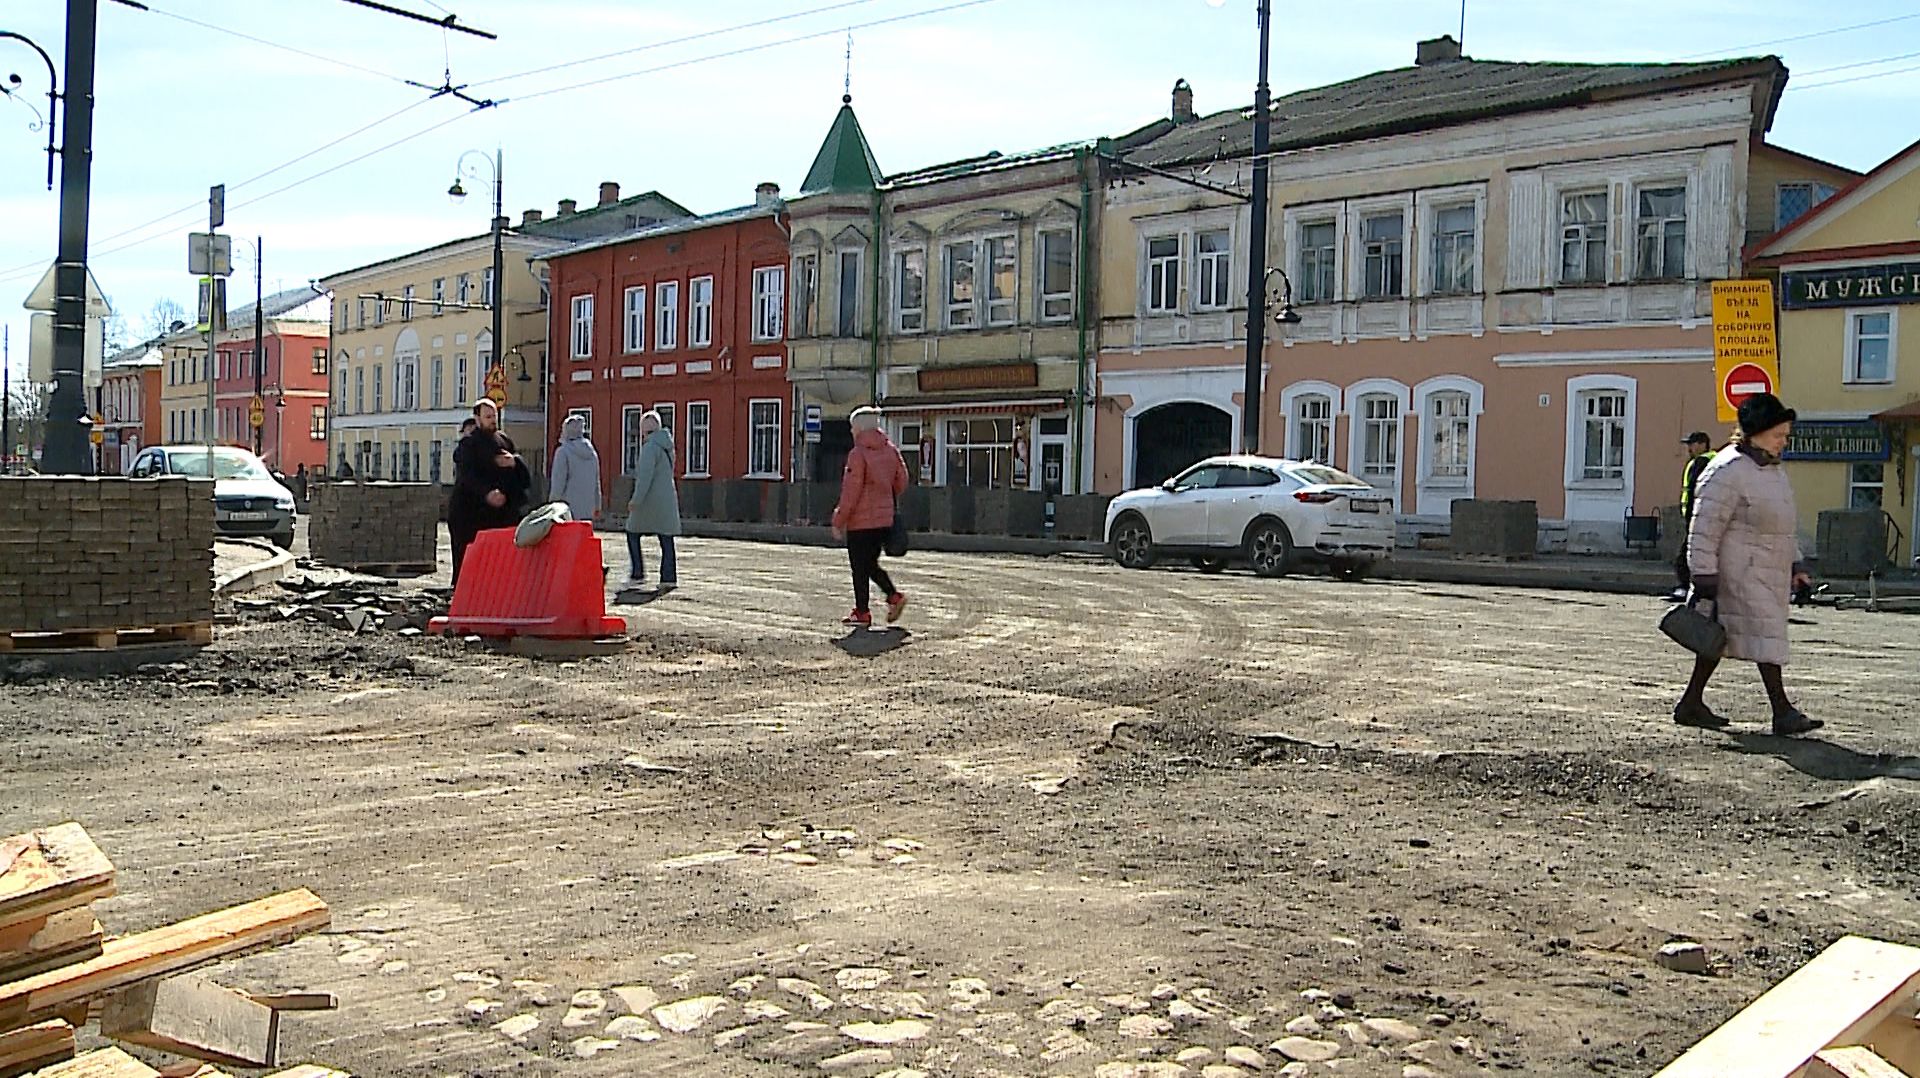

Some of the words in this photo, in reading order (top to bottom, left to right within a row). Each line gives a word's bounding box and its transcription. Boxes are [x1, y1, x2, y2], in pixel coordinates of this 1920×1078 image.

[1713, 285, 1770, 294] ВНИМАНИЕ!
[1726, 298, 1759, 307] ВЪЕЗД
[1736, 310, 1751, 319] НА
[1716, 322, 1772, 331] СОБОРНУЮ
[1719, 335, 1770, 345] ПЛОЩАДЬ
[1718, 347, 1775, 358] ЗАПРЕЩЕН!
